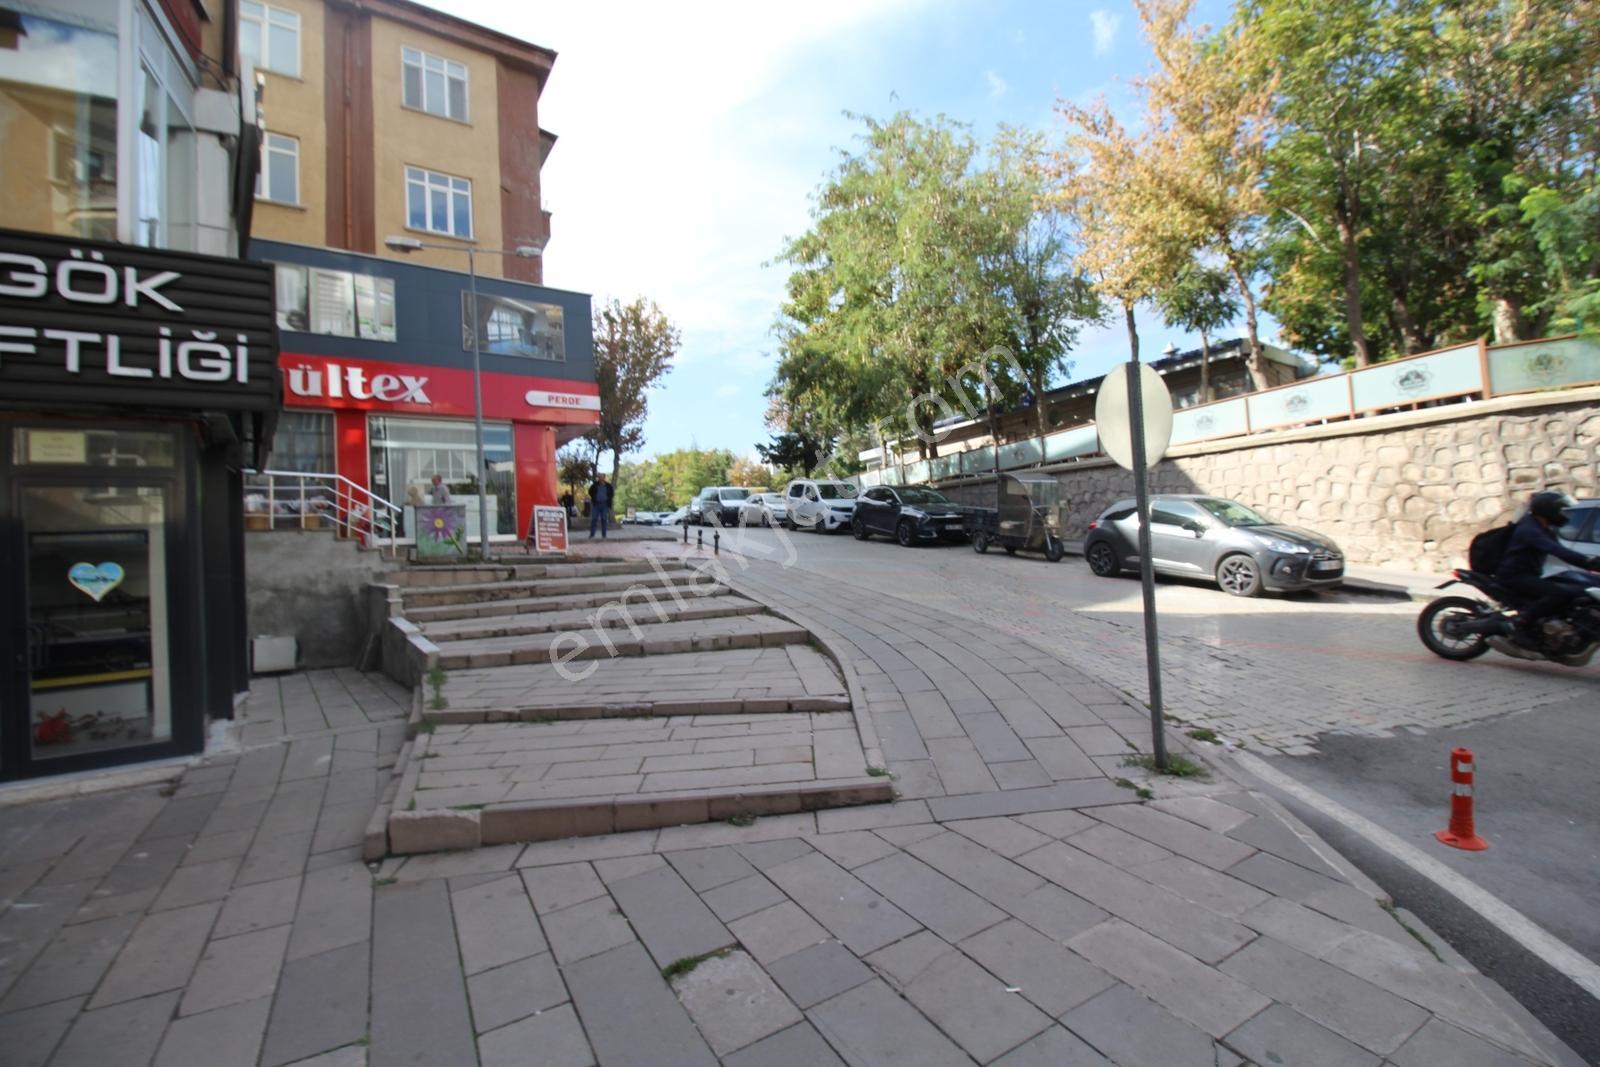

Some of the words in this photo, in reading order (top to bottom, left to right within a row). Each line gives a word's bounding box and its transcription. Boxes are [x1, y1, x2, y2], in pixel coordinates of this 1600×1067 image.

[0, 249, 185, 312] GÖK
[288, 364, 432, 404] ültex
[548, 395, 582, 405] PERDE
